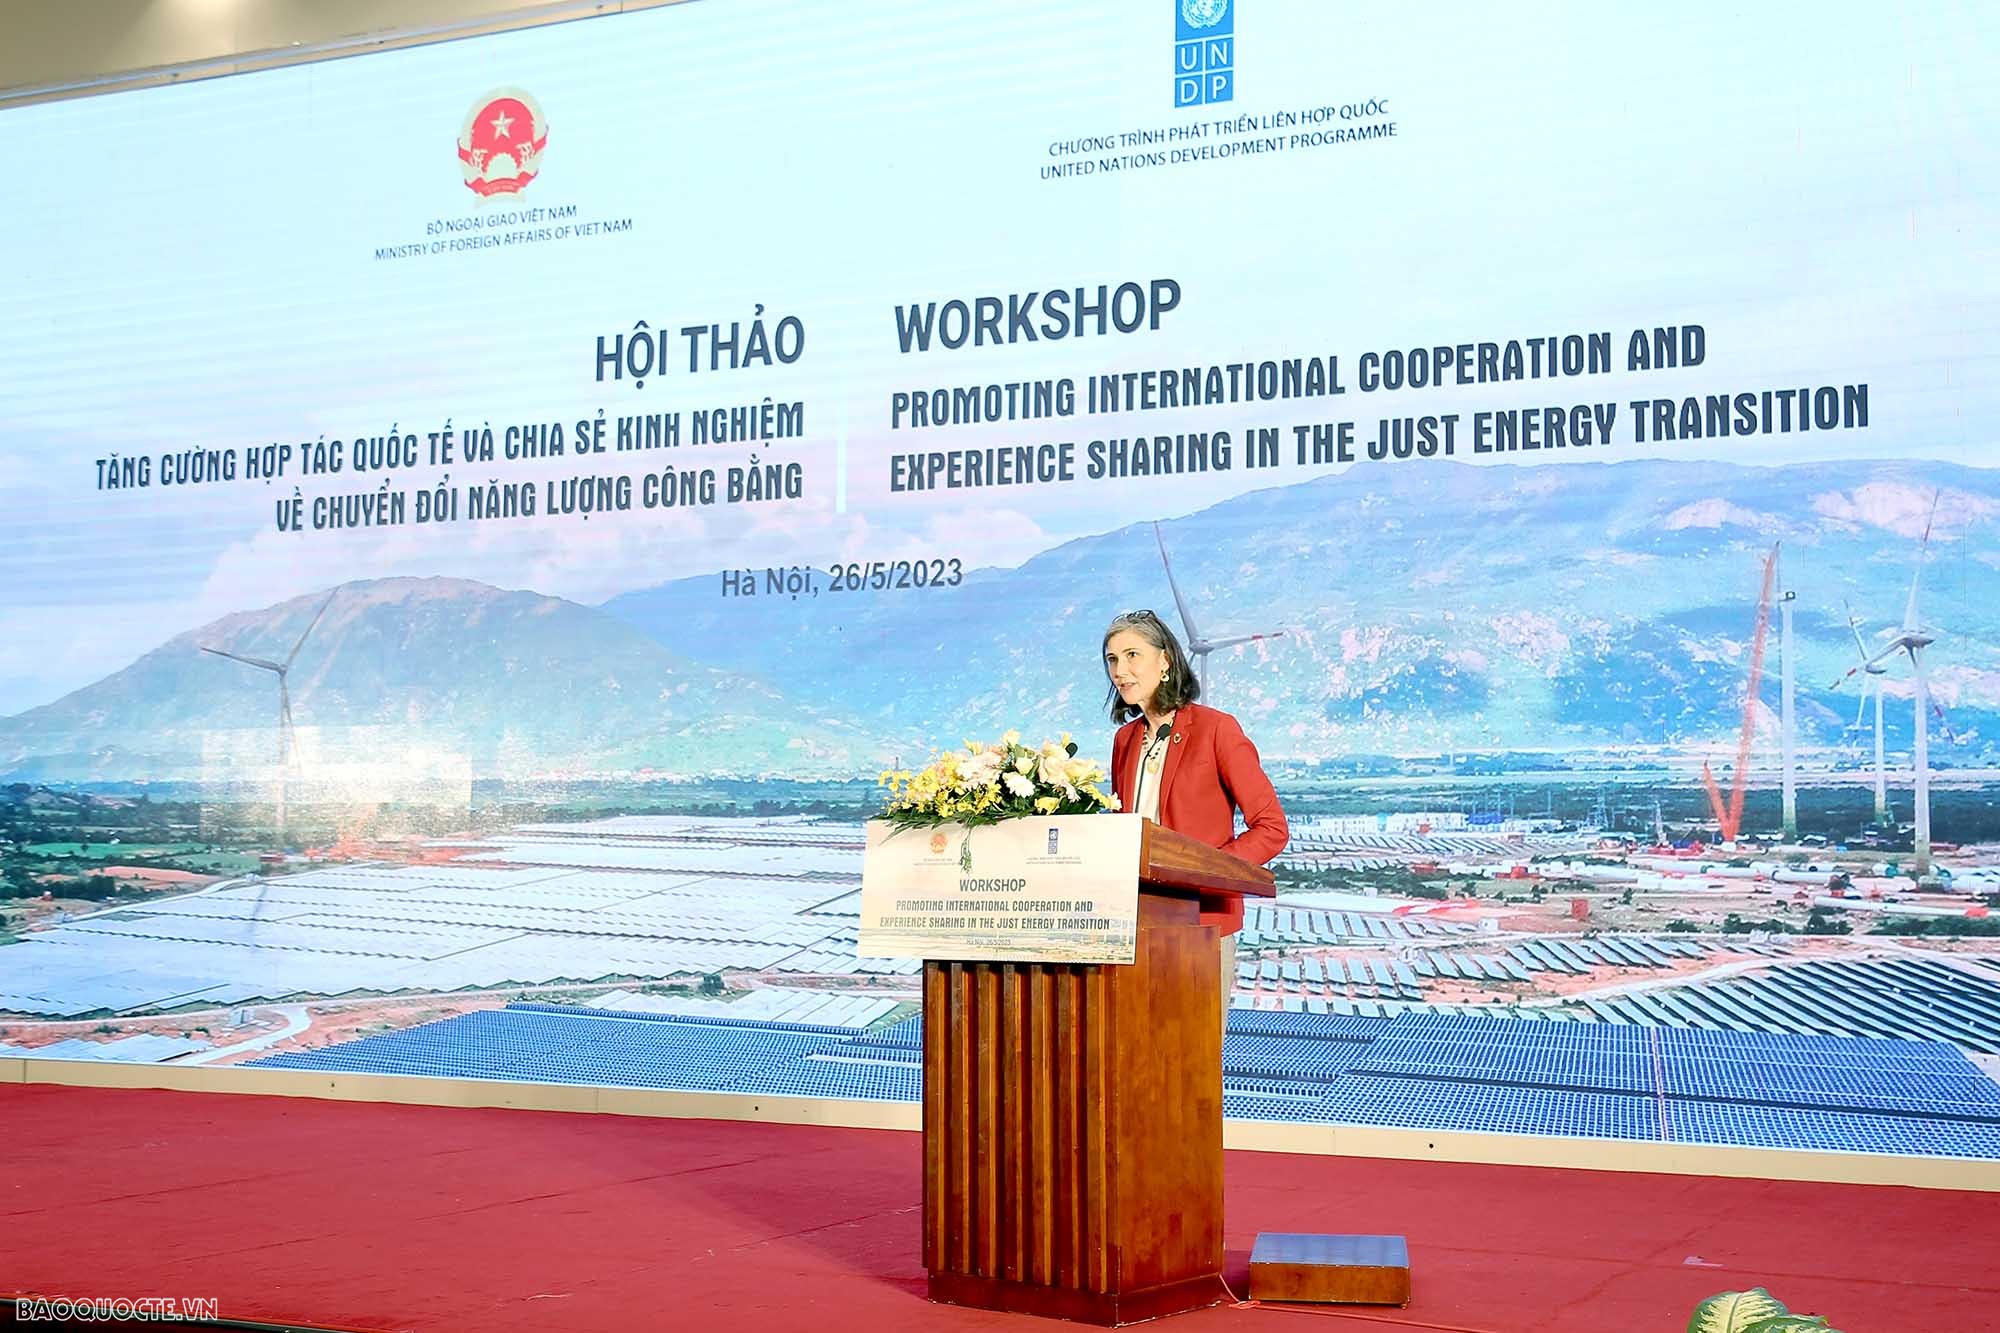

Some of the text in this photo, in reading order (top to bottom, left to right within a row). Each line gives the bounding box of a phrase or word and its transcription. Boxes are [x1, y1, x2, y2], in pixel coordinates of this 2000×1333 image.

[1040, 122, 1398, 180] UNITED NATIONS DEVELOPMENT PROGRAMME
[1049, 134, 1115, 157] CHƯƠNG
[1120, 129, 1165, 148] TRÌNH
[1169, 122, 1210, 142] PHÁT
[1263, 110, 1296, 130] LIÊN
[1301, 106, 1335, 127] HỢP
[1340, 95, 1389, 120] QUỐC
[375, 217, 633, 261] MINISTRY OF FOREIGN AFFAIRS OF VIET NAM
[487, 212, 518, 228] GIAO
[548, 204, 577, 221] NAM
[894, 278, 1182, 354] WORKSHOP
[595, 303, 805, 390] HỘI THẢO
[892, 324, 1706, 430] PROMOTING INTERNATIONAL COOPERATION AND
[96, 396, 804, 490] TĂNG CƯỜNG HỢP TÁC QUỐC TẾ VÀ CHIA SẺ KINH NGHIỆM
[891, 383, 1870, 493] EXPERIENCE SHARING IN THE JUST ENERGY TRANSITION
[276, 453, 803, 533] VỀ CHUYỂN ĐỔI NĂNG LƯỢNG CÔNG BẰNG
[721, 558, 963, 601] Hà Nội, 26/5/2023
[896, 900, 1093, 913] PROMOTING INTERNATIONAL COOPERATION AND
[959, 878, 1026, 893] WORKSHOP
[880, 916, 1110, 931] EXPERIENCE SHARING IN THE JUST ENERGY TRANSITION
